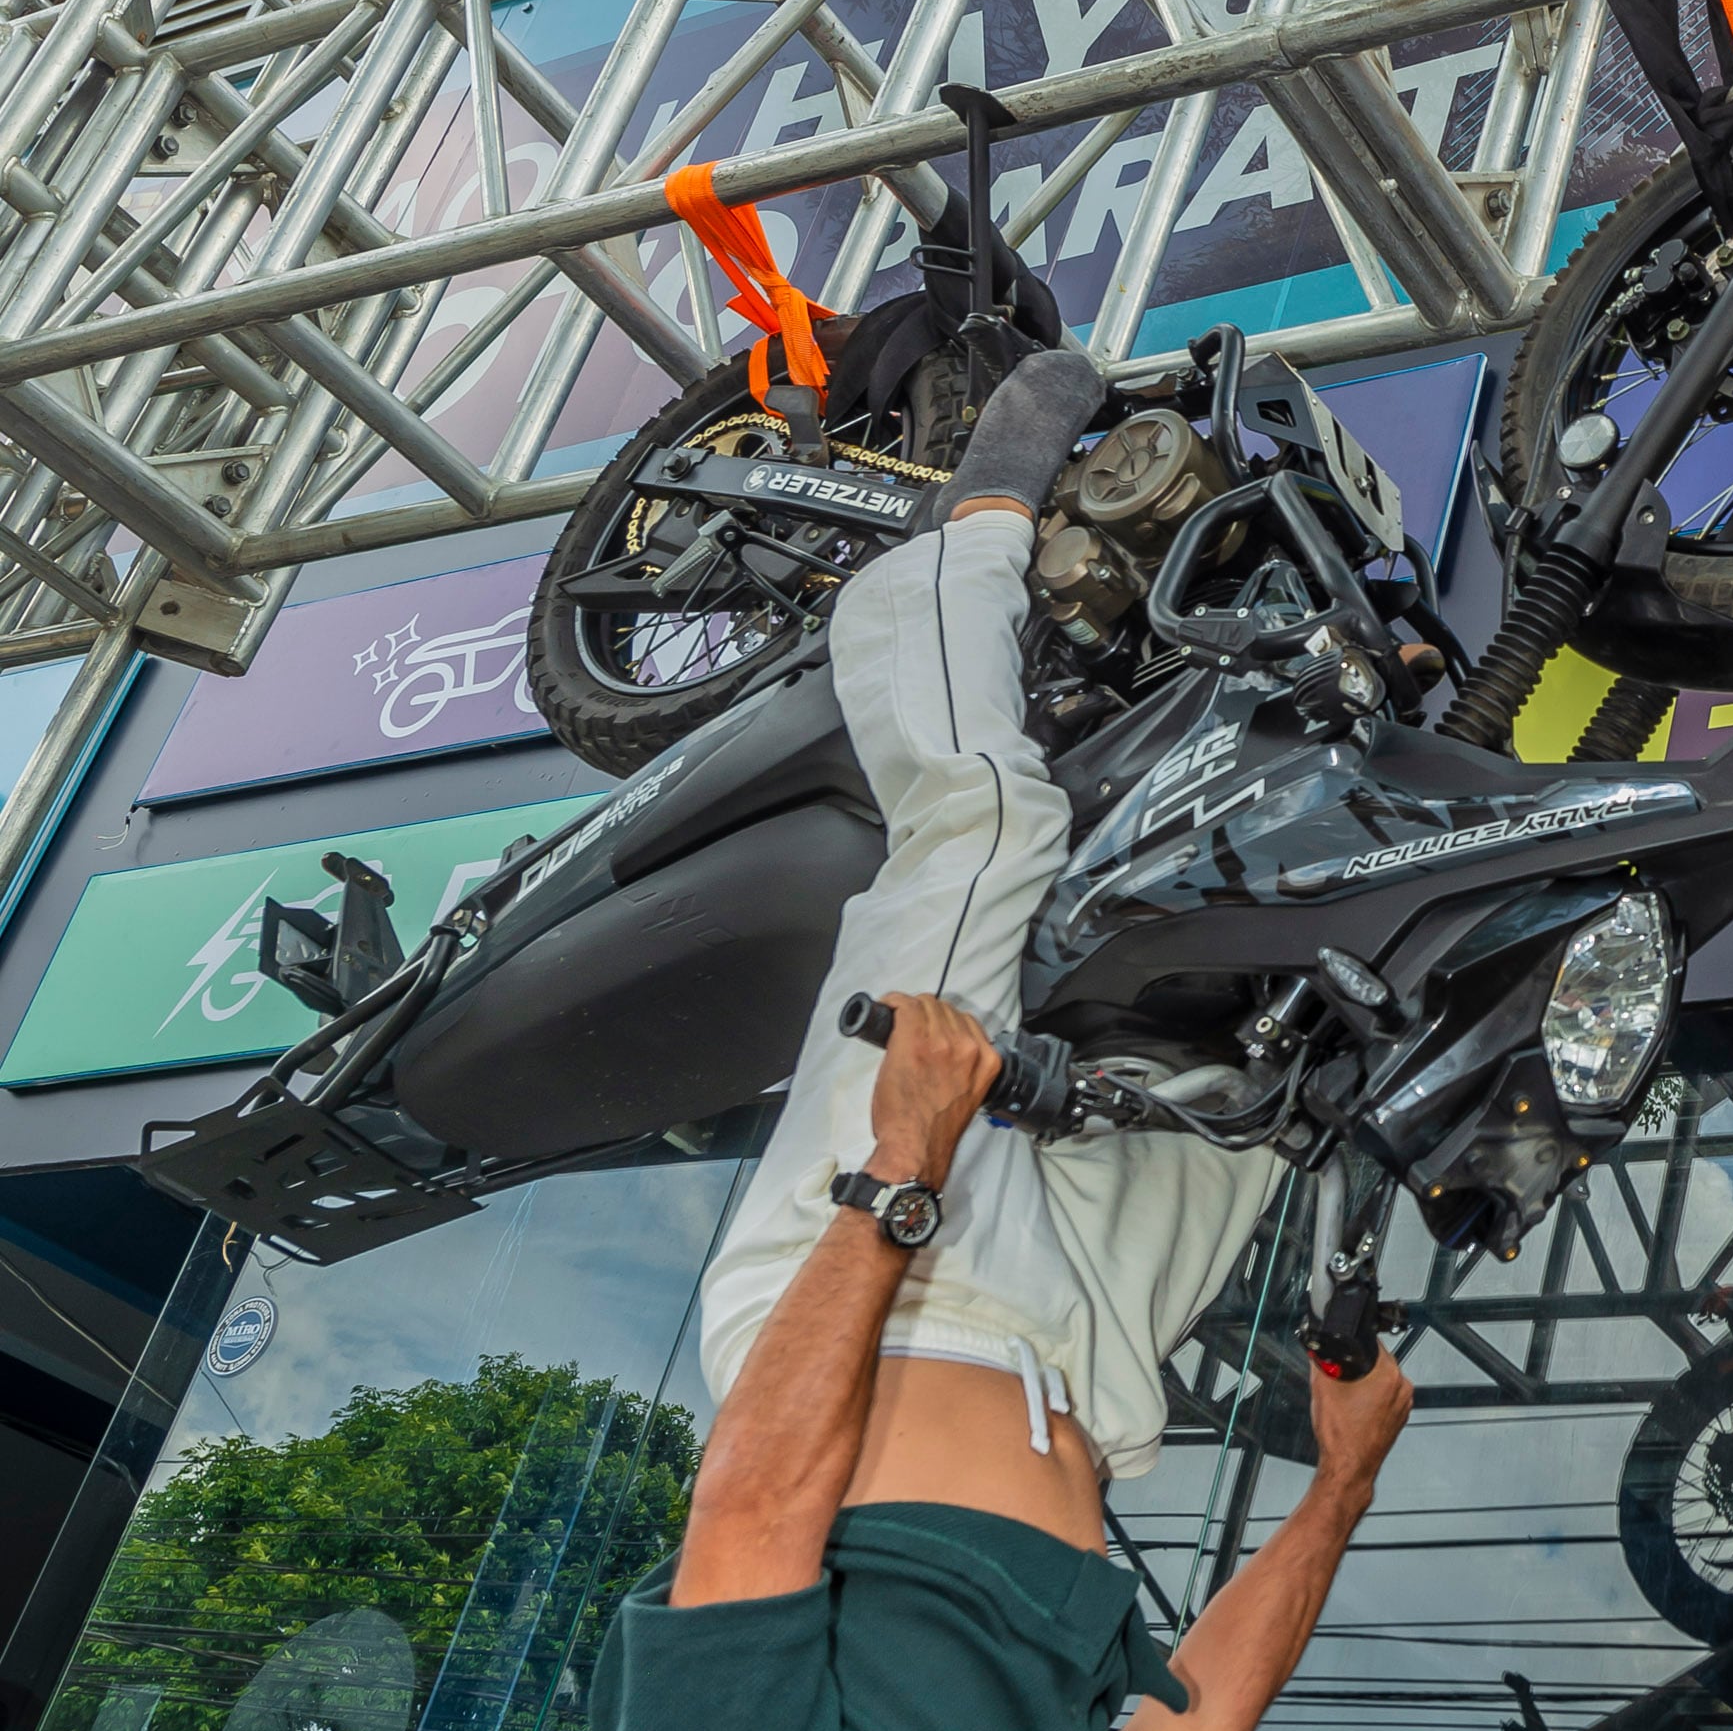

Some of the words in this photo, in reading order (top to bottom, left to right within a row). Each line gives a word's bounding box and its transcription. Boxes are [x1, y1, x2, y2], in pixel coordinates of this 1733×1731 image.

[768, 473, 914, 519] METZELER
[605, 783, 661, 828] DUAL
[607, 755, 686, 819] SPORT
[1509, 793, 1638, 842] RALLY
[514, 807, 610, 903] 200
[1343, 819, 1511, 880] EDITION
